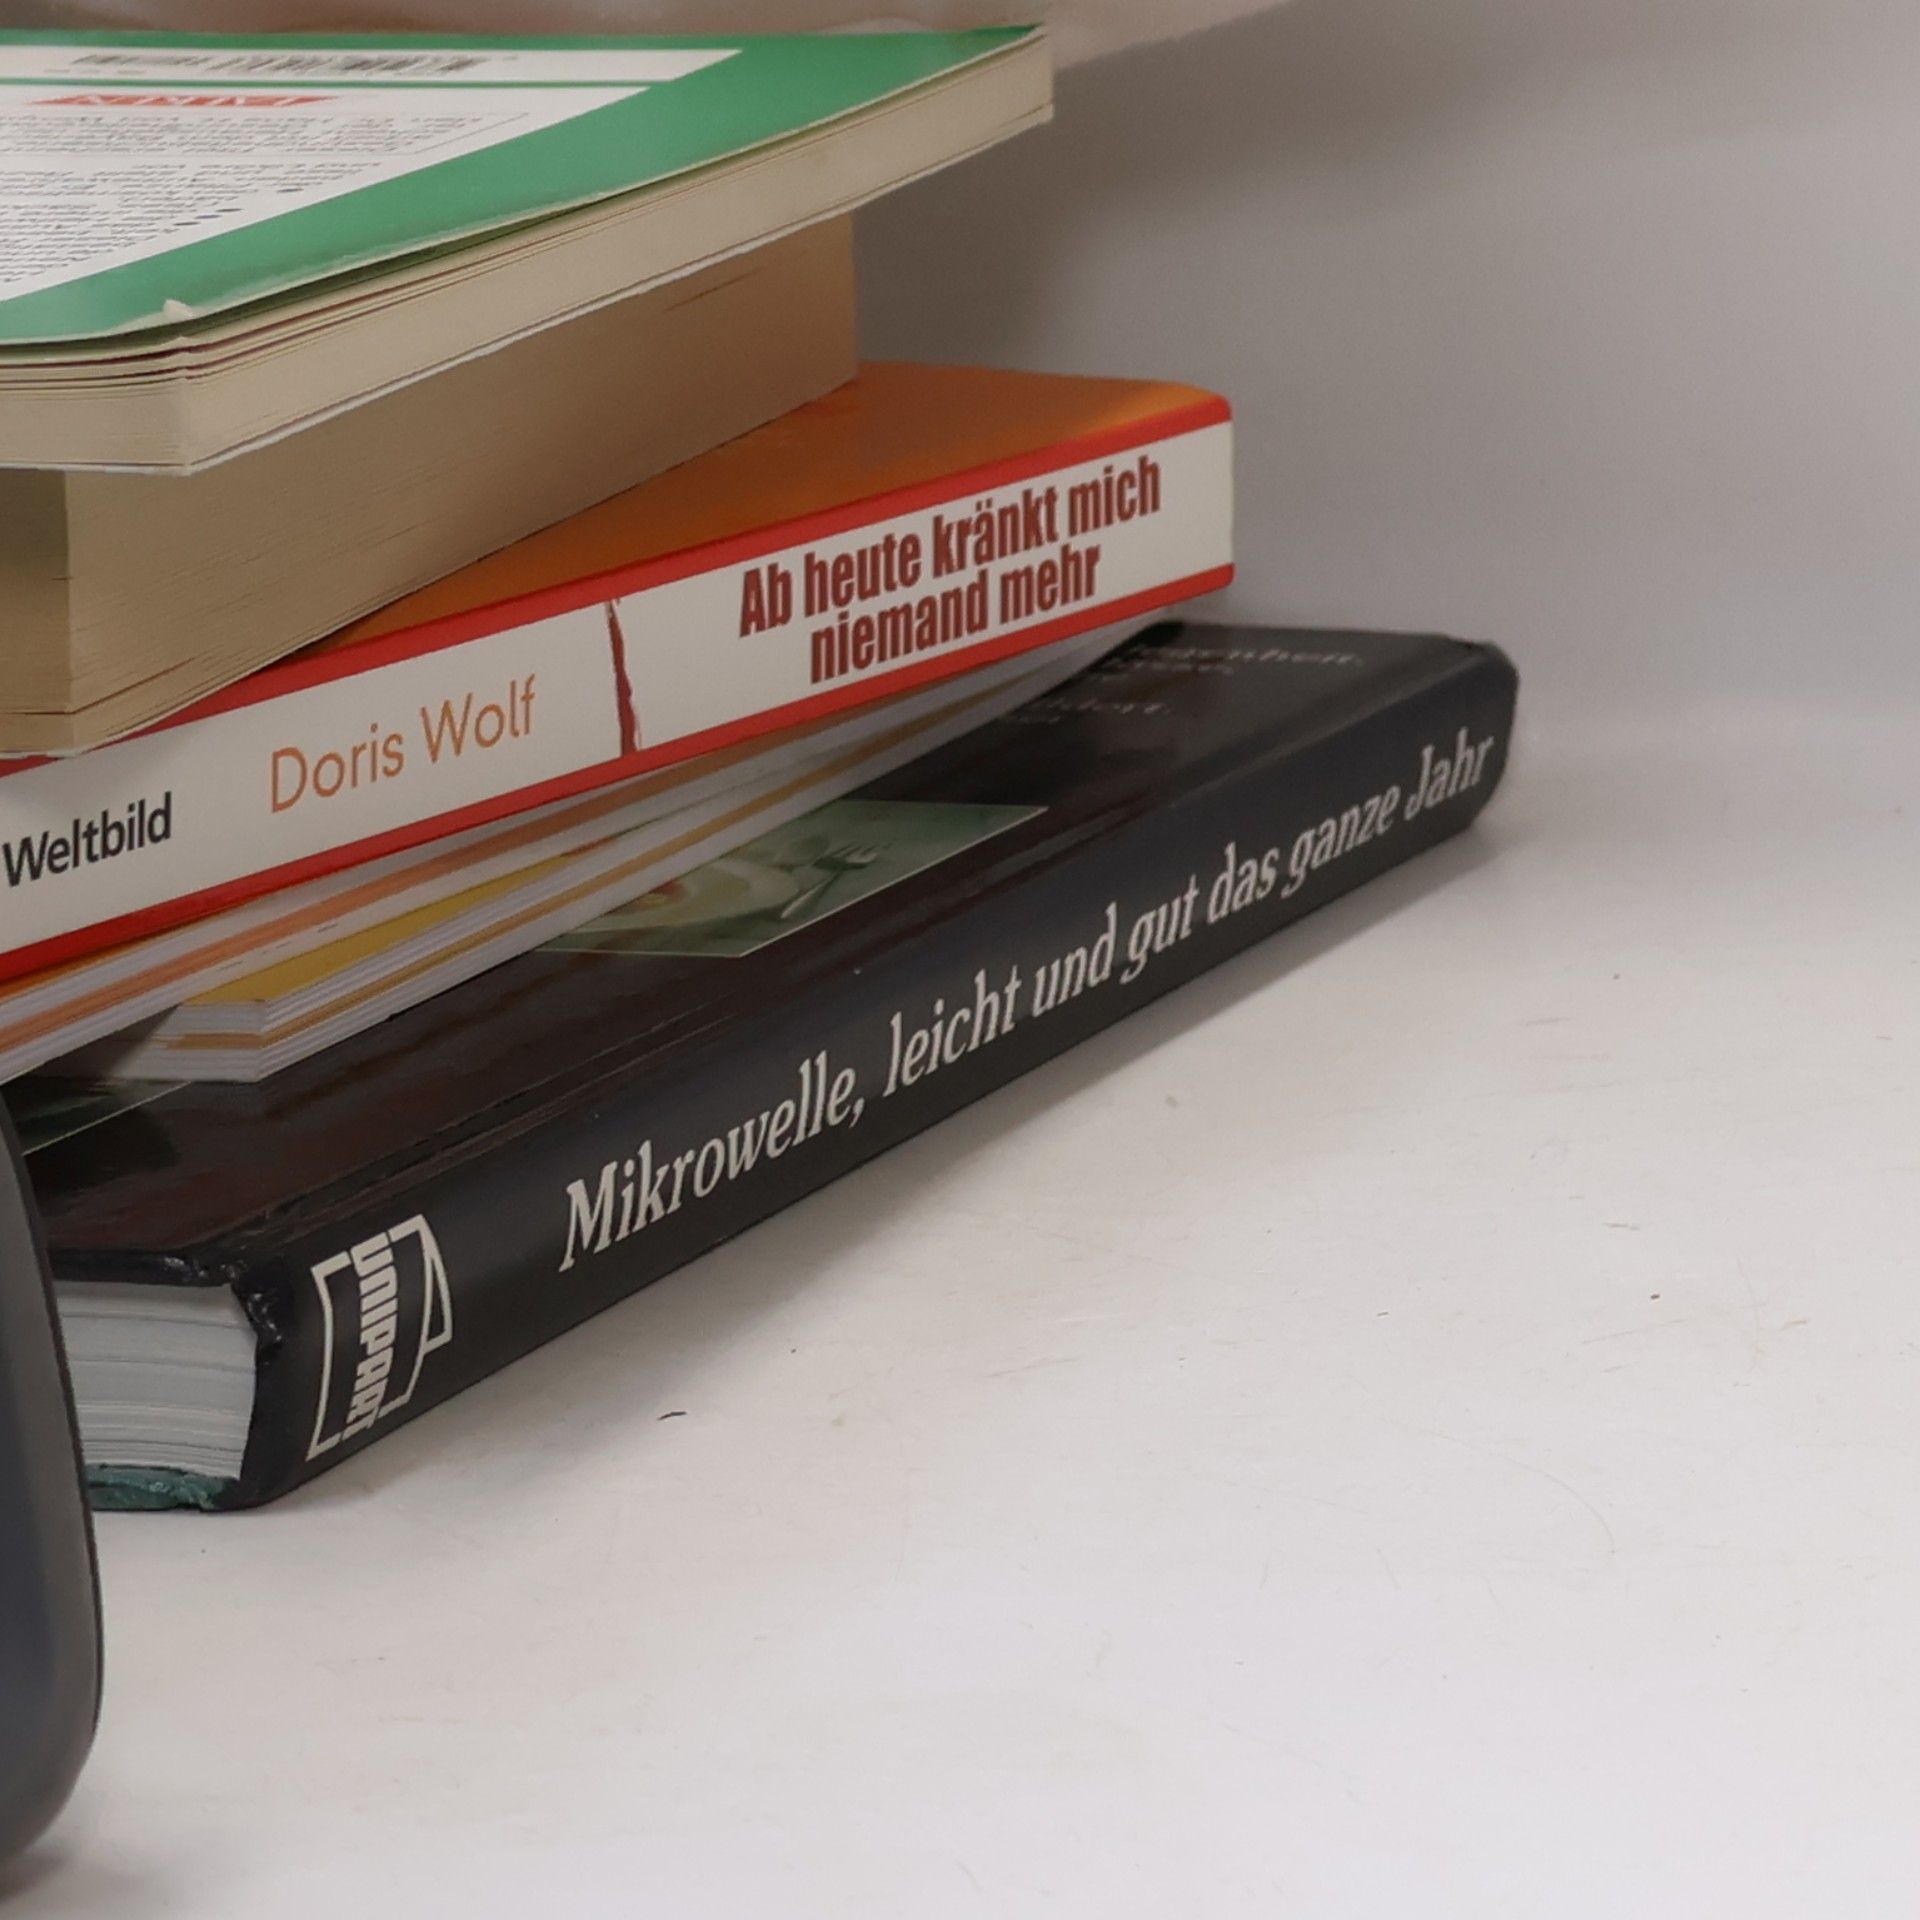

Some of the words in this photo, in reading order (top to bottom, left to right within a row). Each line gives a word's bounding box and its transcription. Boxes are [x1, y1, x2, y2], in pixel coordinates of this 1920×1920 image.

[739, 562, 793, 639] Ab
[804, 531, 922, 619] heute
[932, 485, 1058, 579] kränkt
[1067, 454, 1162, 538] mich
[810, 568, 989, 685] niemand
[999, 543, 1102, 625] mehr
[270, 722, 405, 814] Doris
[419, 672, 537, 765] Wolf
[1, 790, 173, 889] Weltbild
[557, 1049, 866, 1274] Mikrowelle,
[881, 963, 1024, 1099] leicht
[1033, 901, 1118, 1018] und
[1119, 873, 1200, 985] gut
[1206, 841, 1279, 926] das
[1280, 783, 1401, 900] ganze
[1403, 726, 1495, 821] Jahr
[339, 1230, 400, 1442] UNIPART
